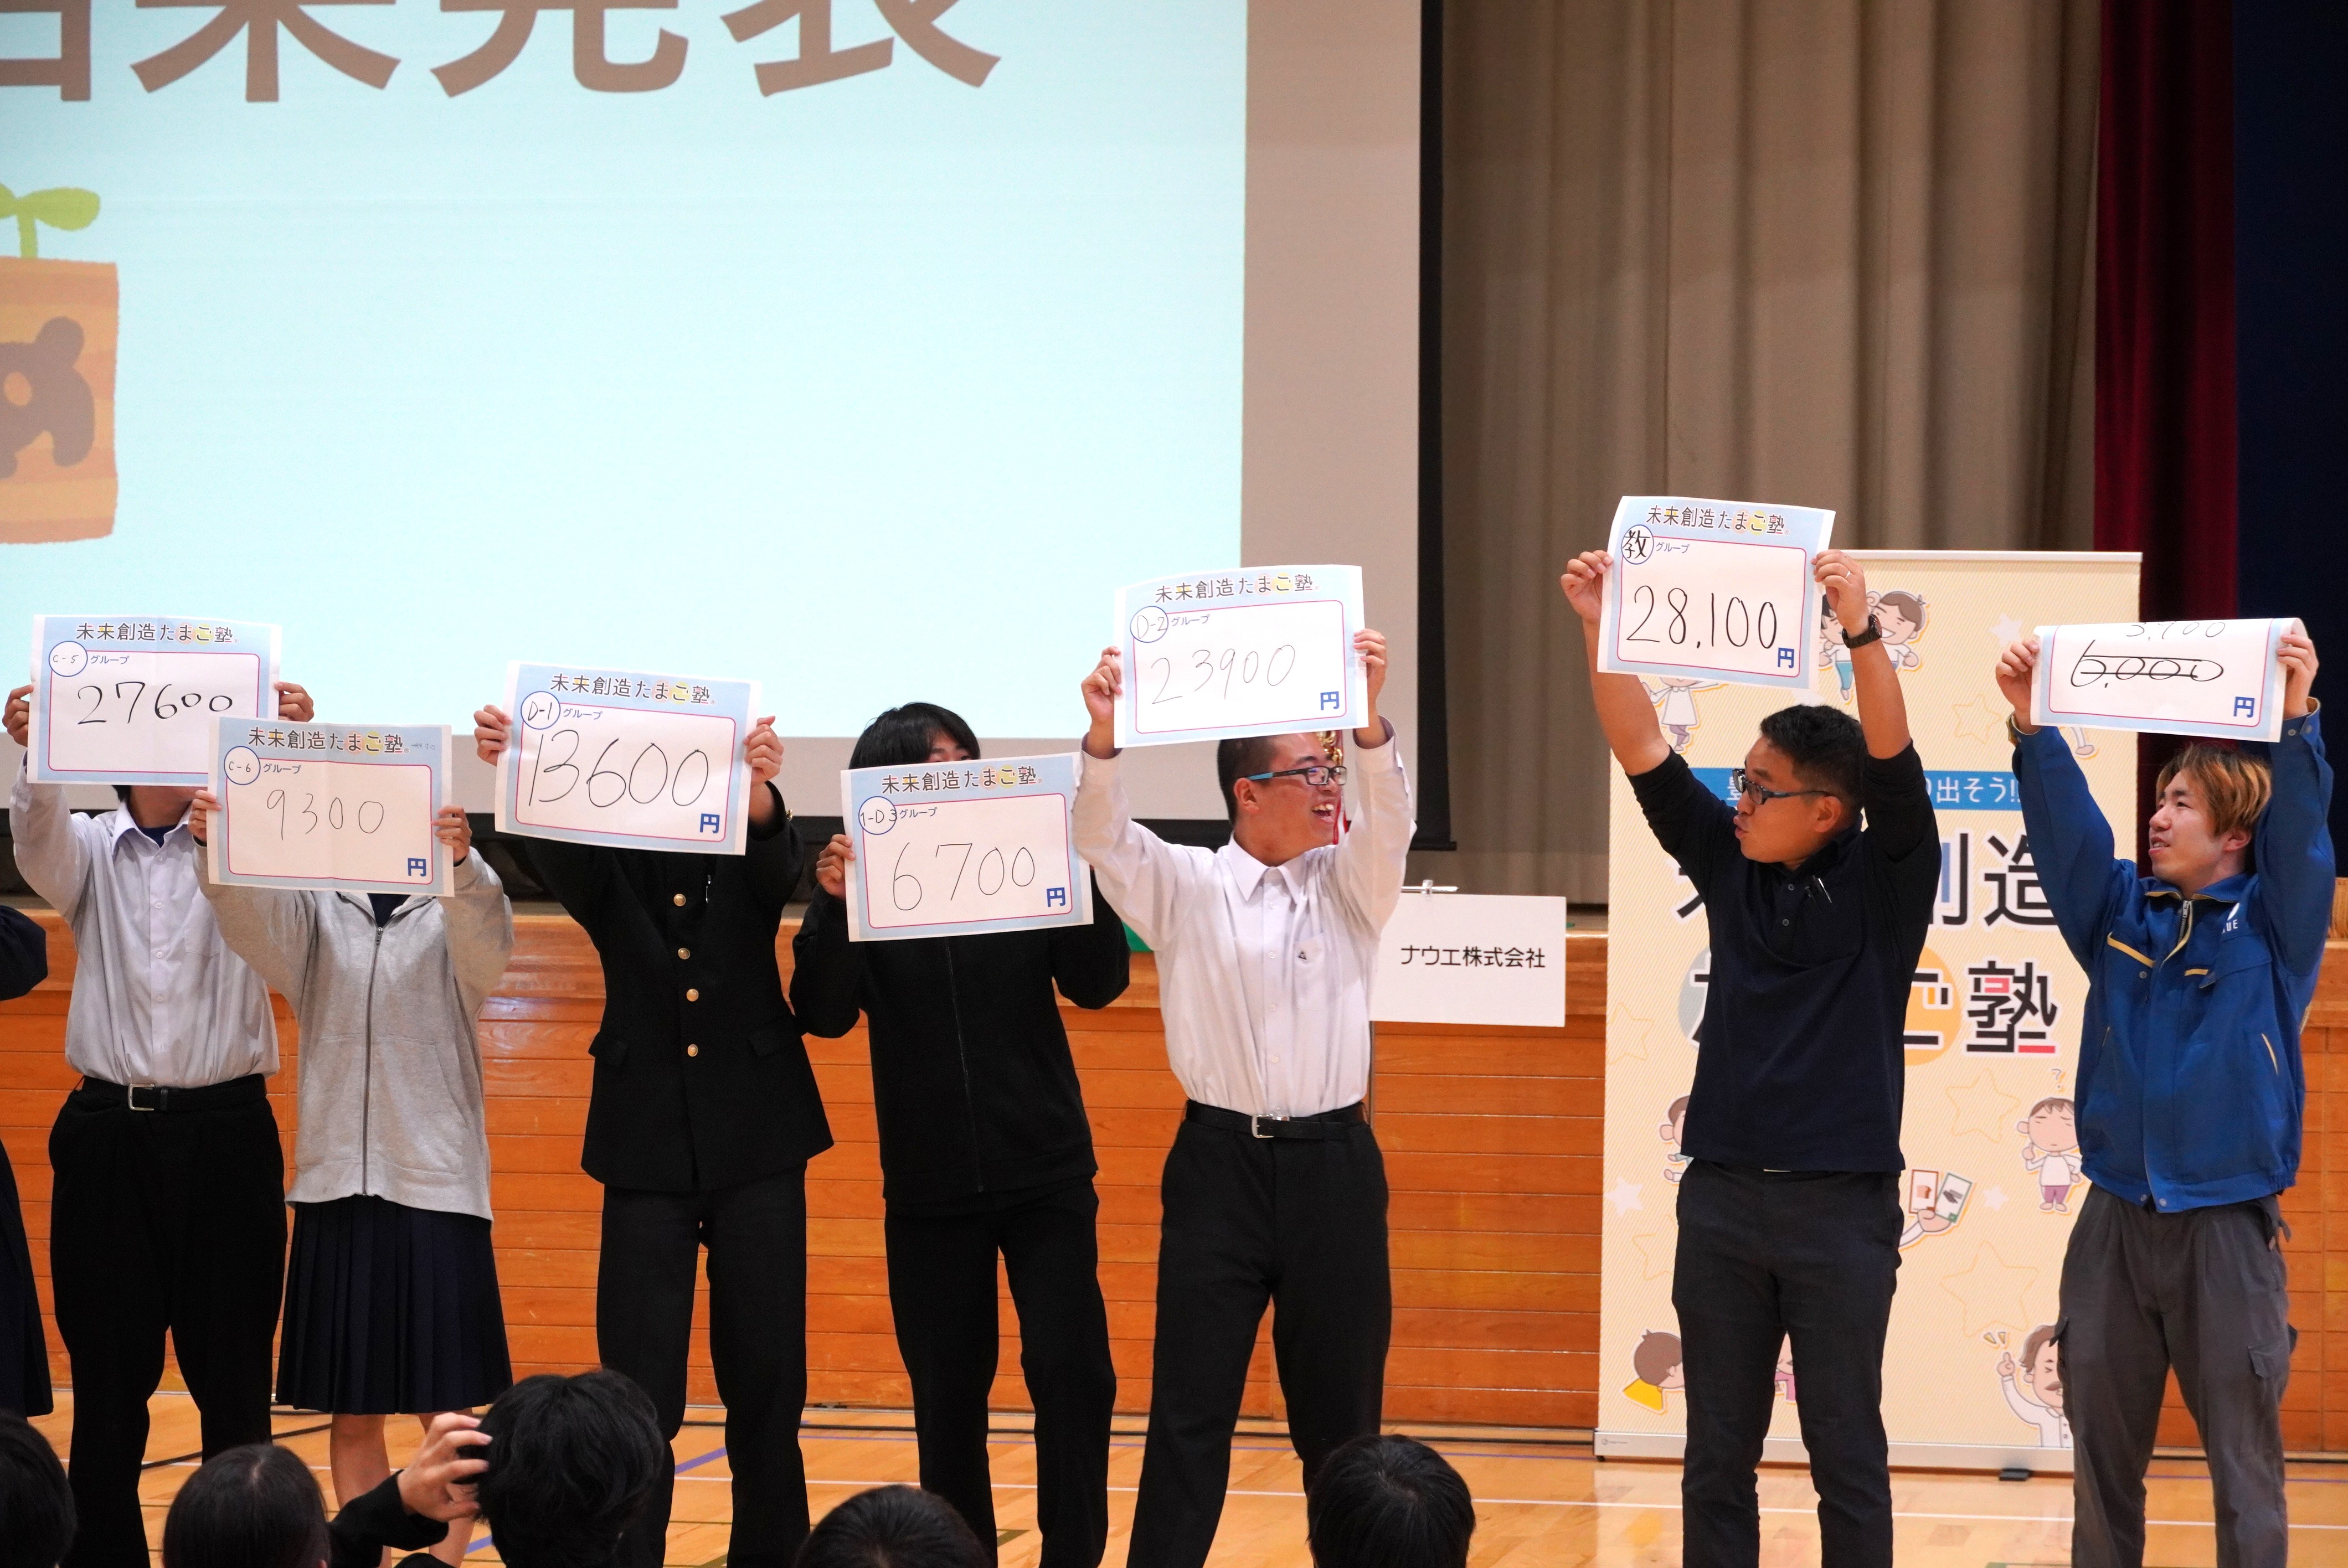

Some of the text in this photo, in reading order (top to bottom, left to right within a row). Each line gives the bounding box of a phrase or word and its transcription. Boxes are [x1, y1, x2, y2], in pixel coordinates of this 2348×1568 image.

[1622, 529, 1690, 559] 教 グループ
[1136, 615, 1211, 639] D-2 グループ
[53, 654, 130, 664] C-5 グループ
[1777, 647, 1795, 669] 円
[1151, 644, 1296, 705] 23900
[77, 680, 233, 725] 27600
[1320, 691, 1340, 711] 円
[2233, 695, 2256, 718] 円
[563, 708, 603, 720] グループ
[228, 761, 302, 775] C-6 グループ
[528, 729, 709, 808] 13600
[267, 789, 384, 841] 9300
[699, 813, 720, 834] 円
[899, 807, 938, 819] グループ
[407, 857, 427, 878] 円
[893, 842, 1035, 911] 6700
[1046, 887, 1067, 908] 円
[1400, 945, 1546, 969] ナウエ株式会社
